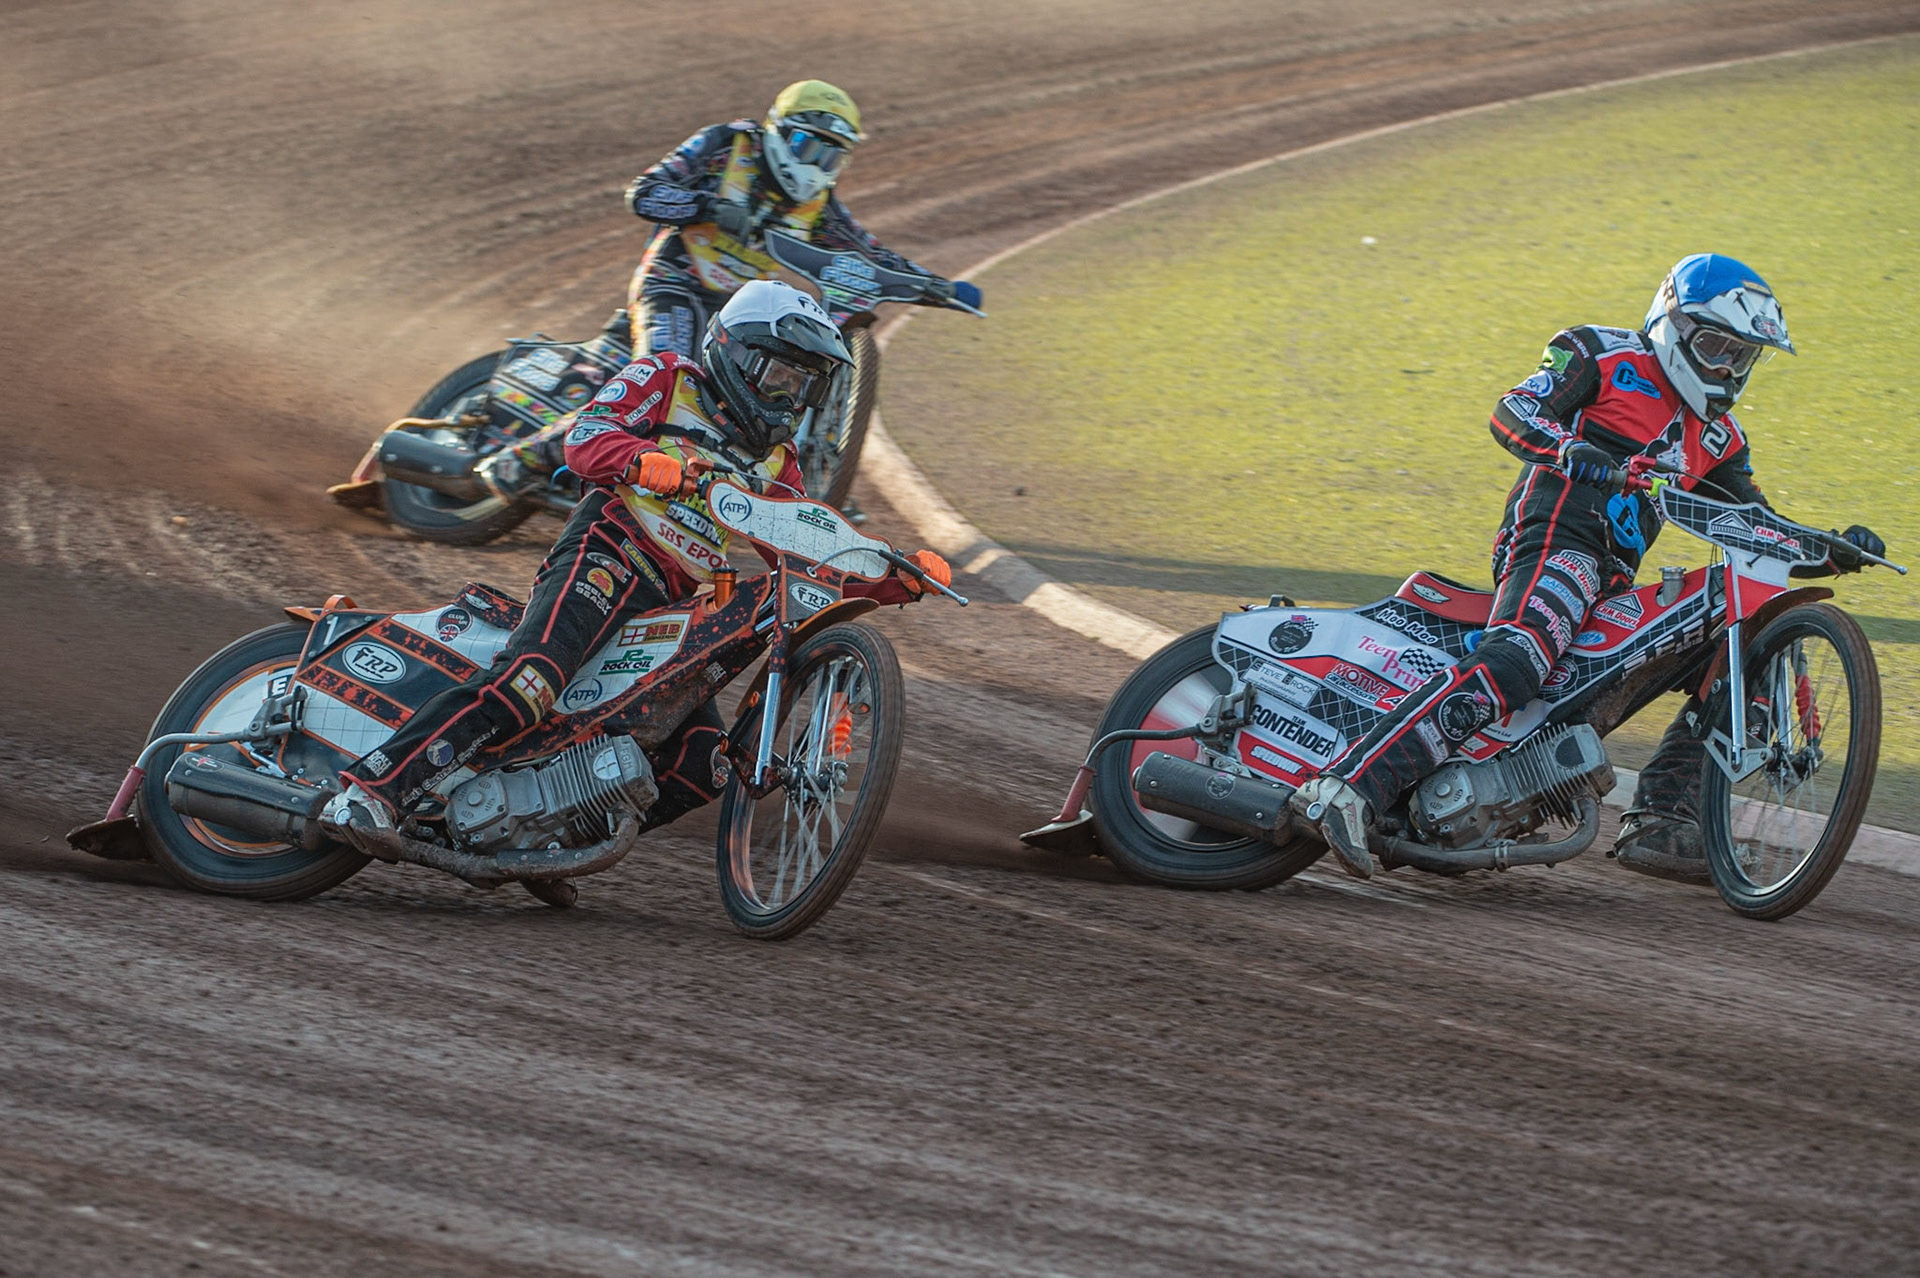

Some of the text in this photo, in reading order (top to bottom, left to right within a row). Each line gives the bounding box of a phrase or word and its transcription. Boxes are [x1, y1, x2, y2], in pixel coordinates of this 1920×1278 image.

[722, 502, 747, 515] ATPI
[797, 512, 837, 531] ROCK OIL
[1755, 526, 1775, 539] CHM
[657, 522, 685, 549] SBS
[1550, 554, 1577, 574] CHM
[575, 586, 608, 616] BEACH
[1377, 608, 1438, 644] Moo Moo
[1596, 605, 1616, 618] CHM
[1615, 611, 1639, 627] Doors
[323, 616, 338, 646] 1
[645, 623, 680, 636] NEB
[1358, 635, 1398, 658] Teen
[600, 660, 652, 671] ROCK OIL
[1250, 661, 1283, 680] STEVE
[1282, 673, 1315, 695] BROCK
[1331, 663, 1390, 697] MOTIVE
[568, 689, 598, 701] ATPI
[1253, 704, 1335, 758] CONTENDER
[1250, 745, 1303, 775] SPEEDWAY
